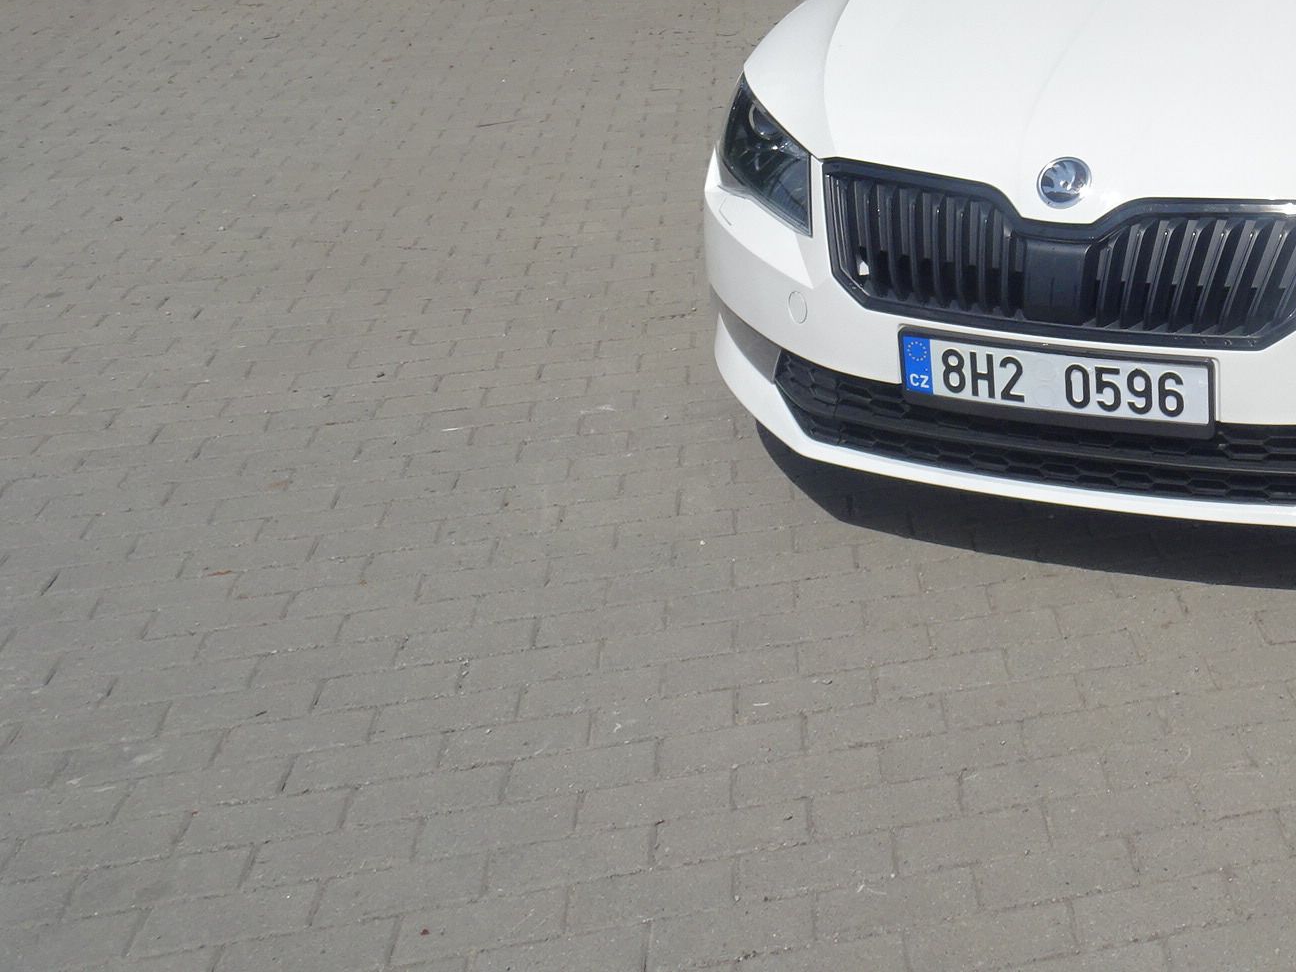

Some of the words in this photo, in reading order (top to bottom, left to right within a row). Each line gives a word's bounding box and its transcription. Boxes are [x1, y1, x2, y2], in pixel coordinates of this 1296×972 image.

[909, 372, 930, 389] CZ
[942, 348, 1025, 402] 8H2
[1064, 364, 1184, 417] 0596
